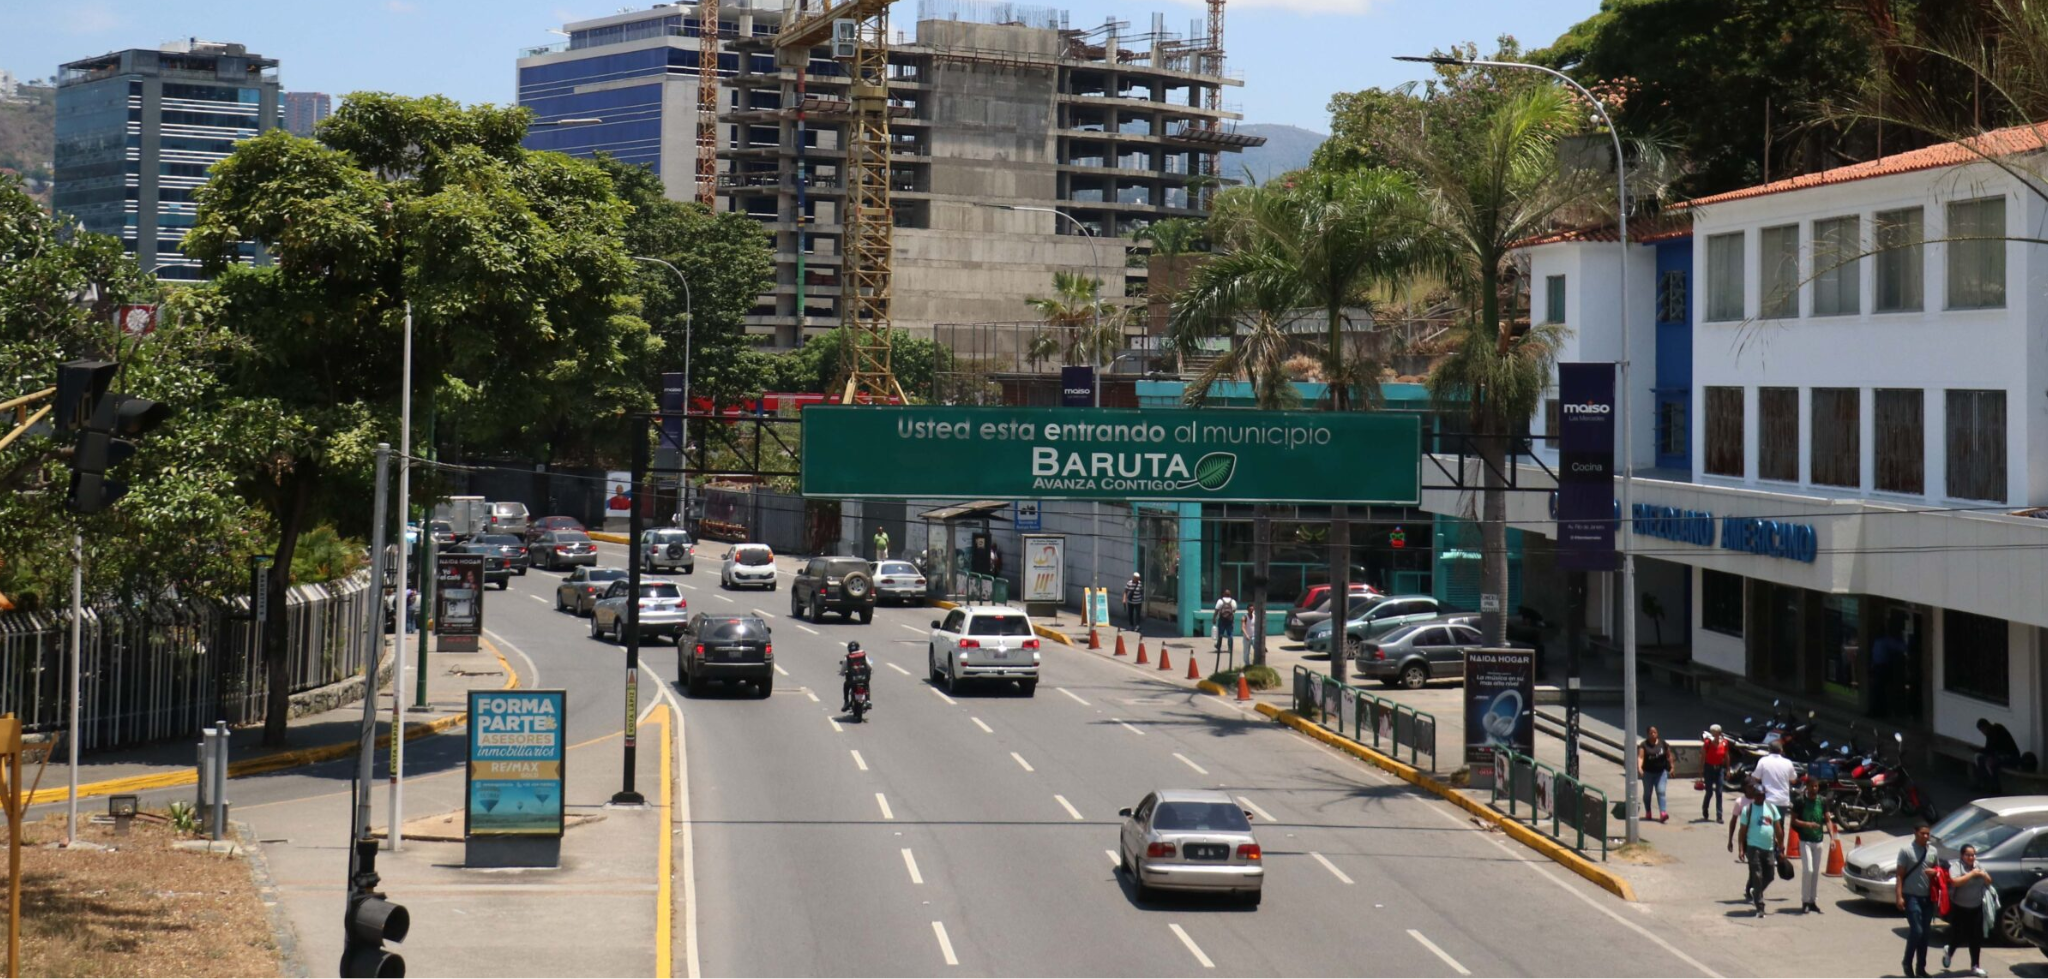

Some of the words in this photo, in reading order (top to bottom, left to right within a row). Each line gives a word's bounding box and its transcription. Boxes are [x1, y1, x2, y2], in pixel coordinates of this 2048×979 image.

[1064, 387, 1091, 395] maiso
[1563, 401, 1610, 414] maiso
[898, 417, 971, 439] Usted
[980, 418, 1035, 440] esta
[1044, 420, 1165, 442] entrando
[1175, 421, 1197, 443] al
[1203, 421, 1331, 449] municipio
[1032, 447, 1190, 478] BARUTA
[1571, 462, 1603, 472] Cocina
[1033, 478, 1097, 490] AVANZA
[1101, 478, 1176, 491] CONTIGO
[1721, 513, 1818, 564] AMERICANO
[1469, 654, 1497, 662] NAIDA
[1498, 655, 1530, 664] HOGAR
[478, 698, 555, 714] FORMA
[478, 715, 548, 732] PARTE
[481, 734, 552, 745] ASESORES
[477, 745, 554, 757] inmobiliarios
[491, 762, 538, 772] RE/MAX
